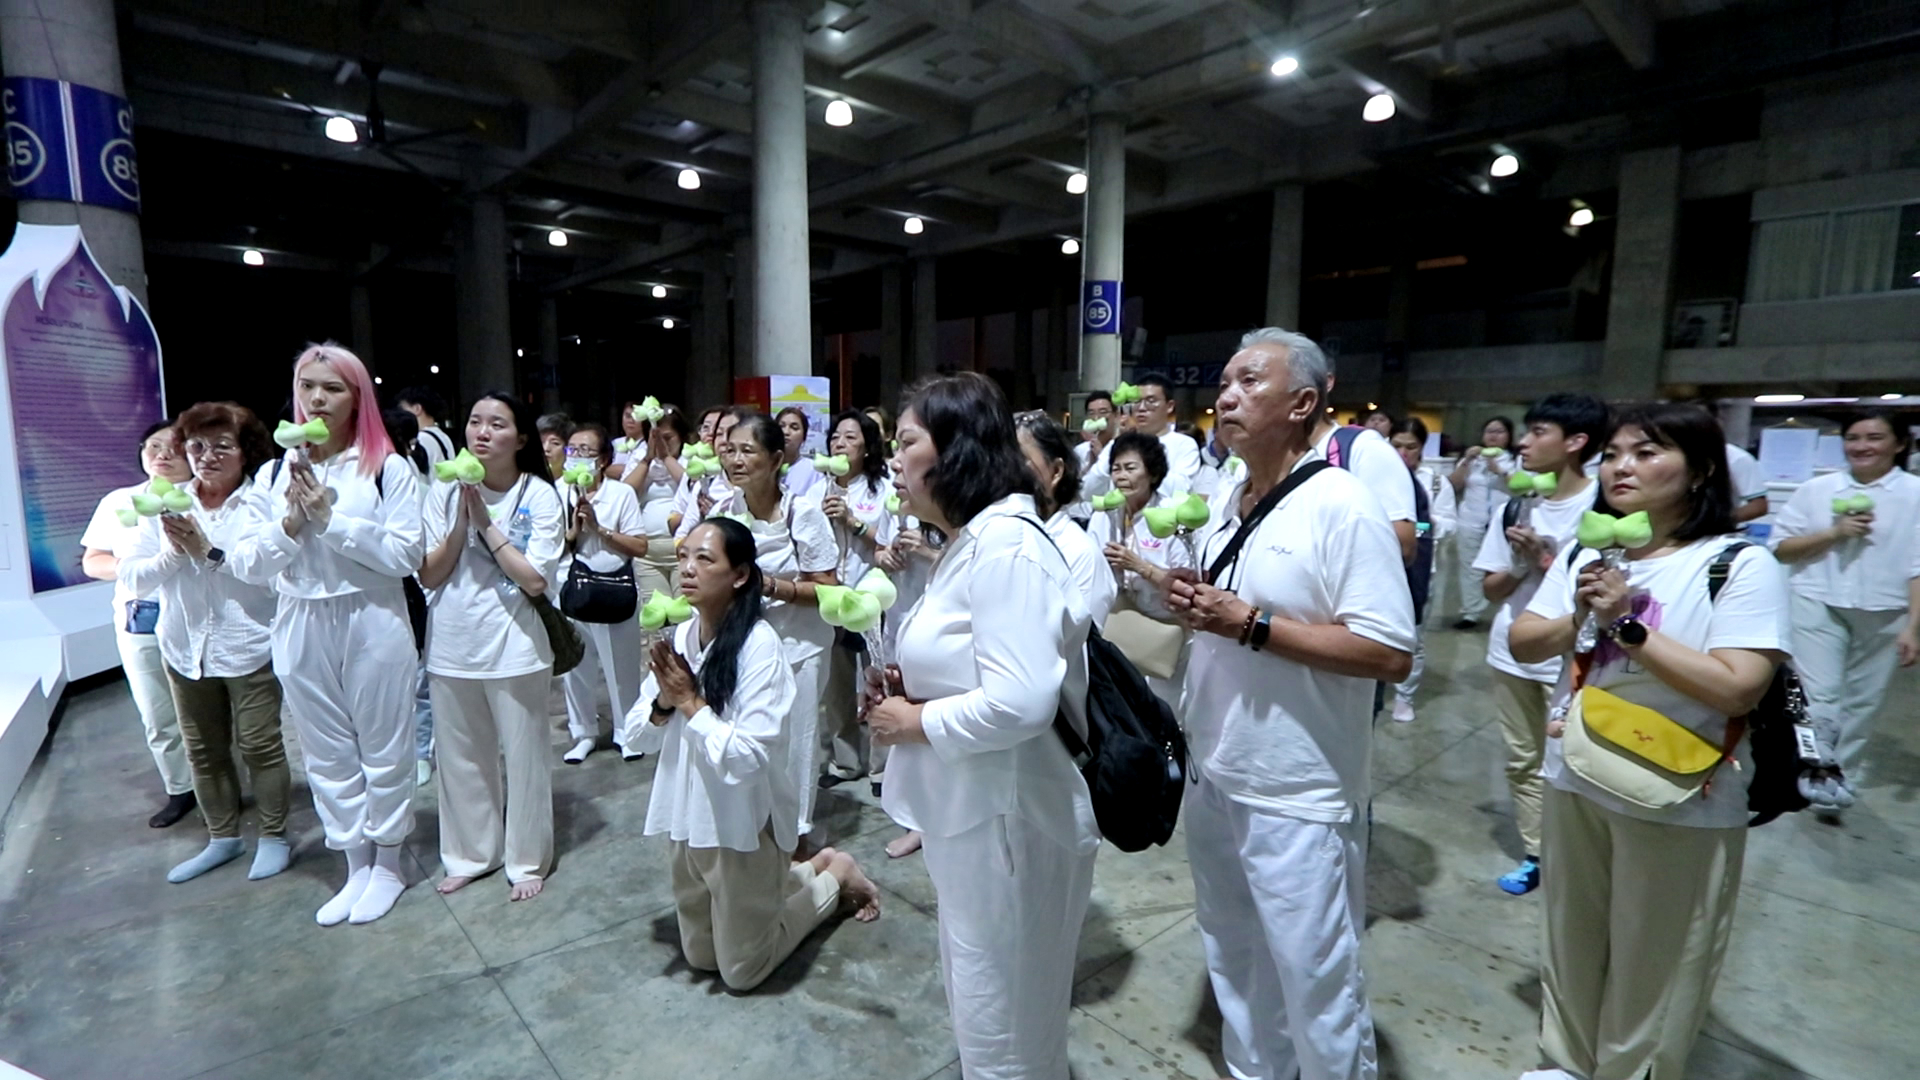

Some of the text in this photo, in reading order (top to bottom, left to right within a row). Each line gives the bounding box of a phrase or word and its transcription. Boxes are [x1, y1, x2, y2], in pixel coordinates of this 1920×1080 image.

[2, 87, 17, 115] C
[1093, 285, 1103, 296] B
[1088, 307, 1107, 319] 85
[1174, 365, 1200, 385] 32
